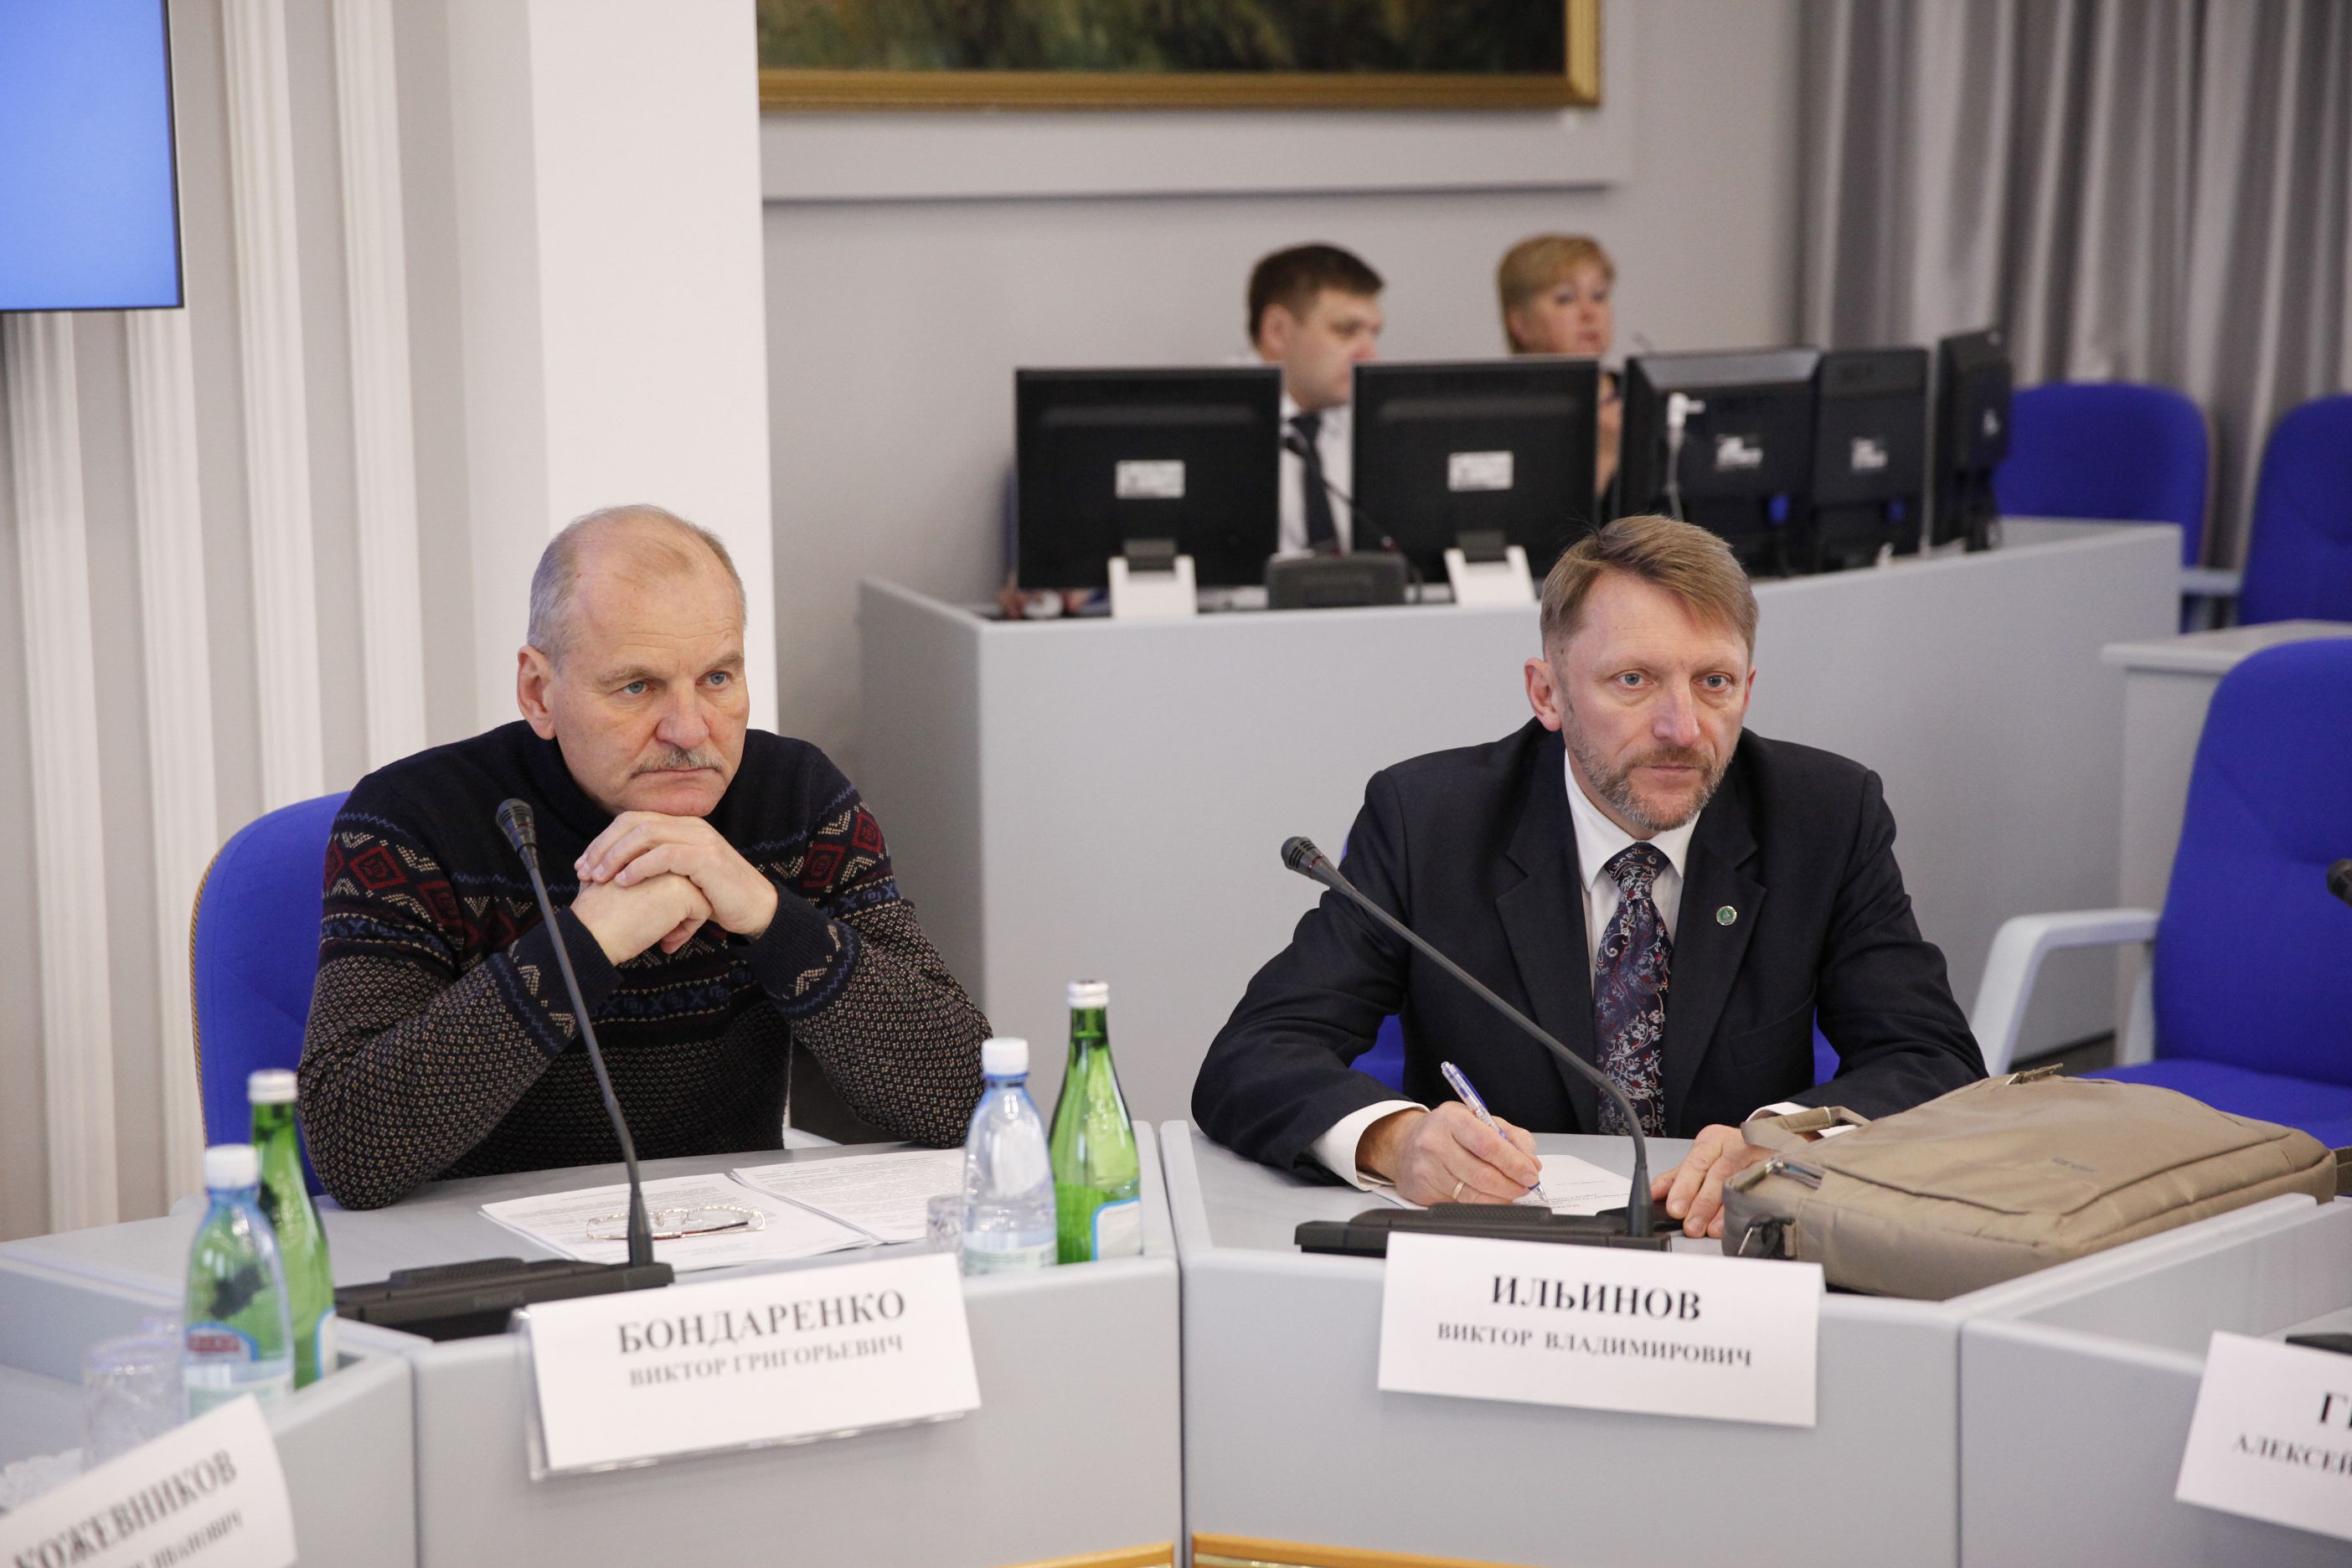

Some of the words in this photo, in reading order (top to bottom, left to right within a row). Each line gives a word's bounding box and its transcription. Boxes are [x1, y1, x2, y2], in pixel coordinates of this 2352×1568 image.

[617, 1289, 906, 1354] БОНДАРЕНКО
[1491, 1274, 1701, 1322] ИЛЬИНОВ
[629, 1357, 726, 1388] ВИКТОР
[734, 1334, 904, 1375] ГРИГОРЬЕВИЧ
[1437, 1322, 1533, 1347] ВИКТОР
[1545, 1332, 1752, 1368] ВЛАДИМИРОВИЧ
